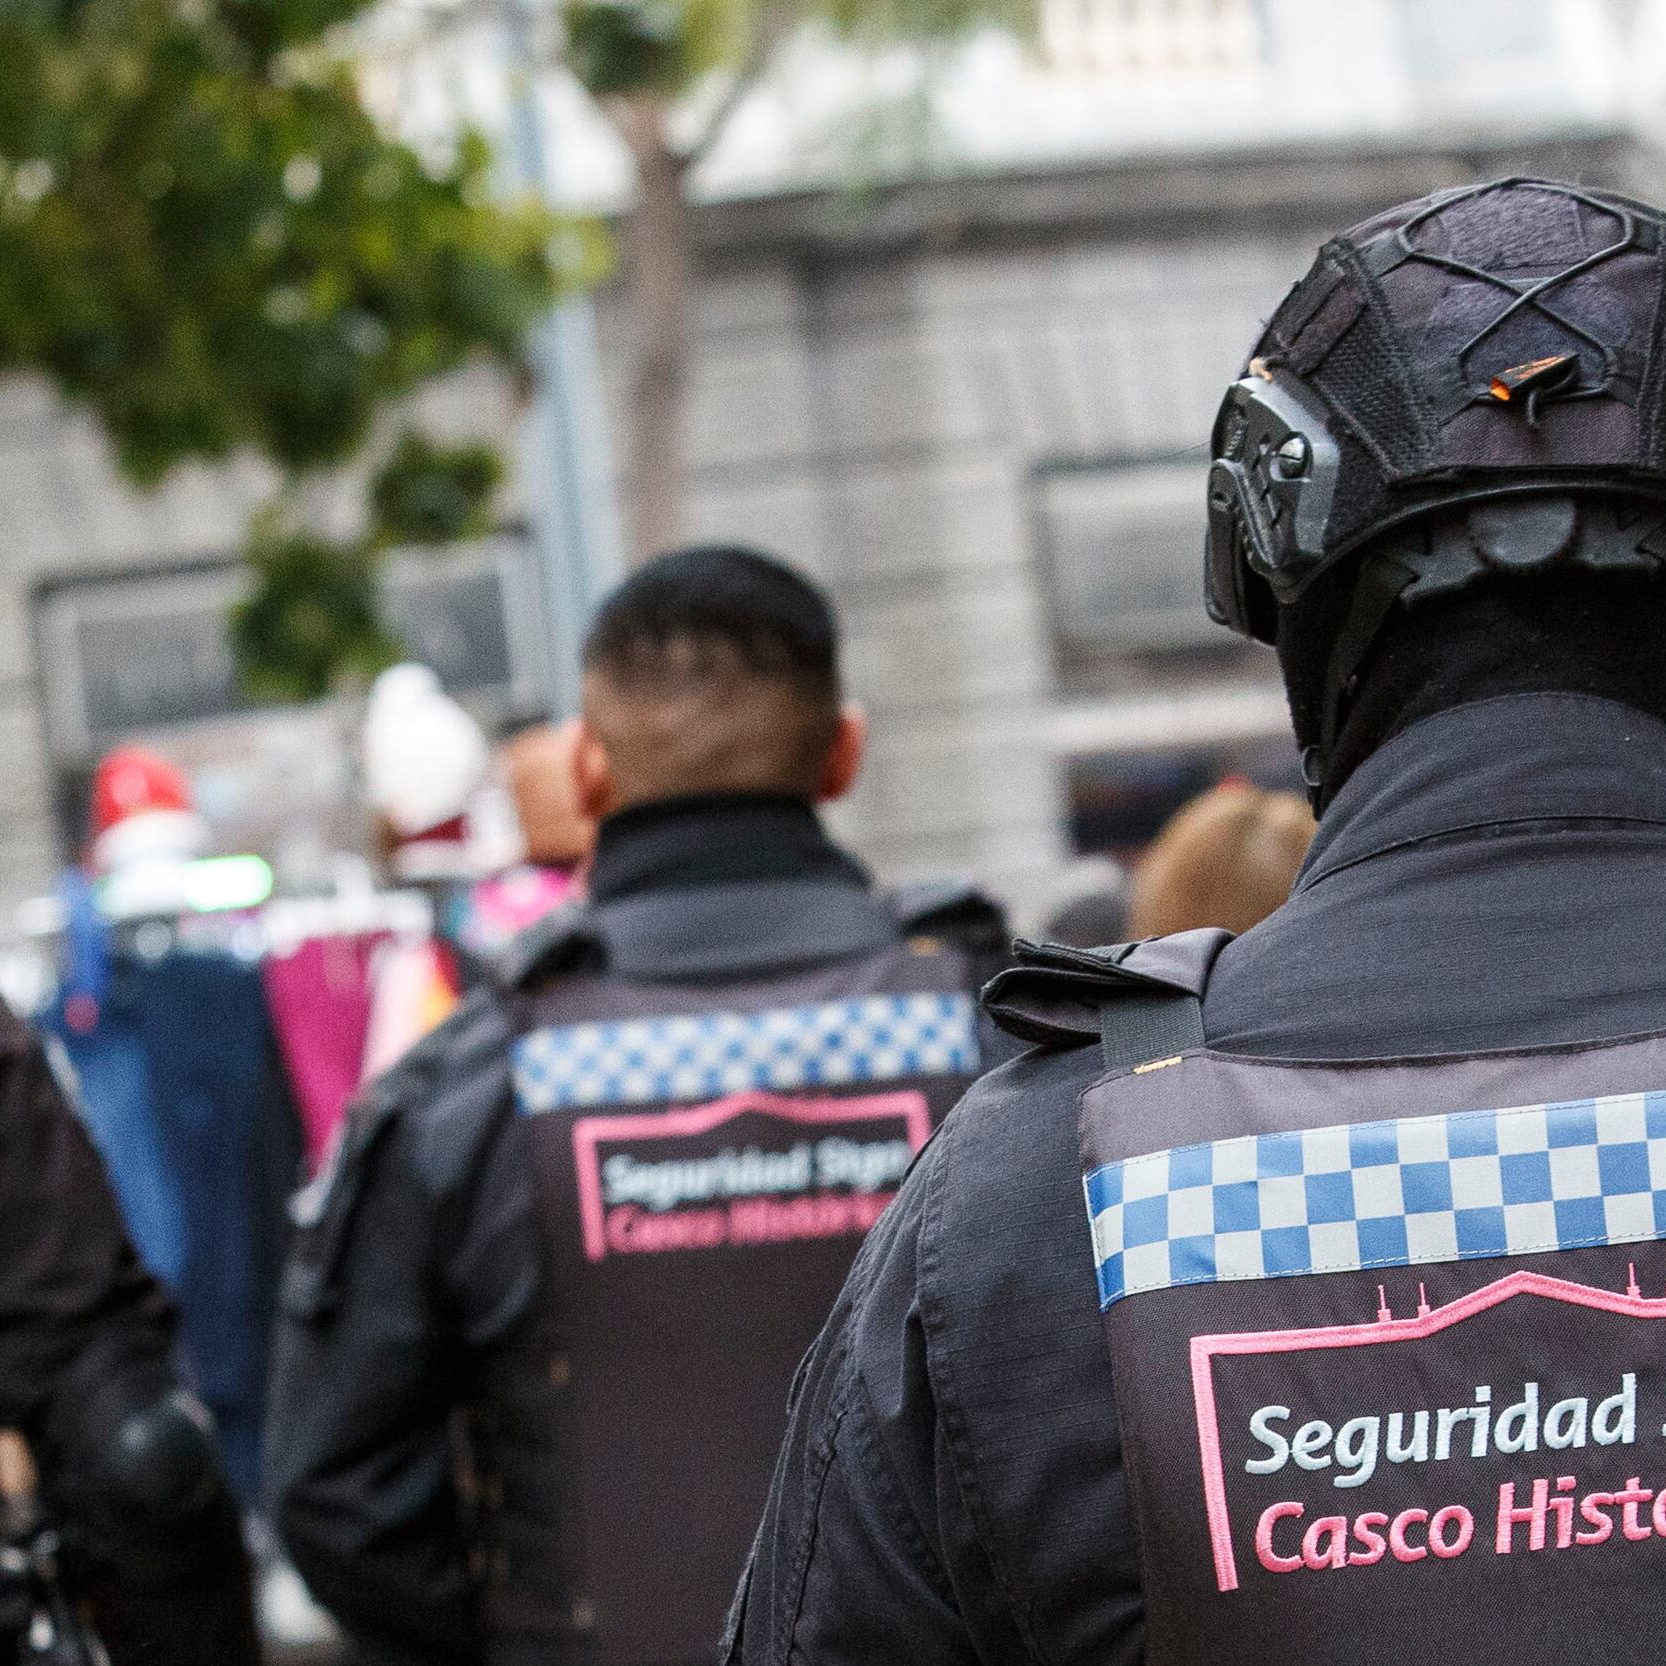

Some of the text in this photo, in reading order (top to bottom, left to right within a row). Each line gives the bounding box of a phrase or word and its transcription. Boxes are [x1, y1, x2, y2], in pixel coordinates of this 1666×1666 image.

[602, 1141, 813, 1211] Seguridad
[729, 1192, 898, 1245] Históri
[1244, 1372, 1637, 1489] Seguridad
[1255, 1500, 1475, 1573] Casco
